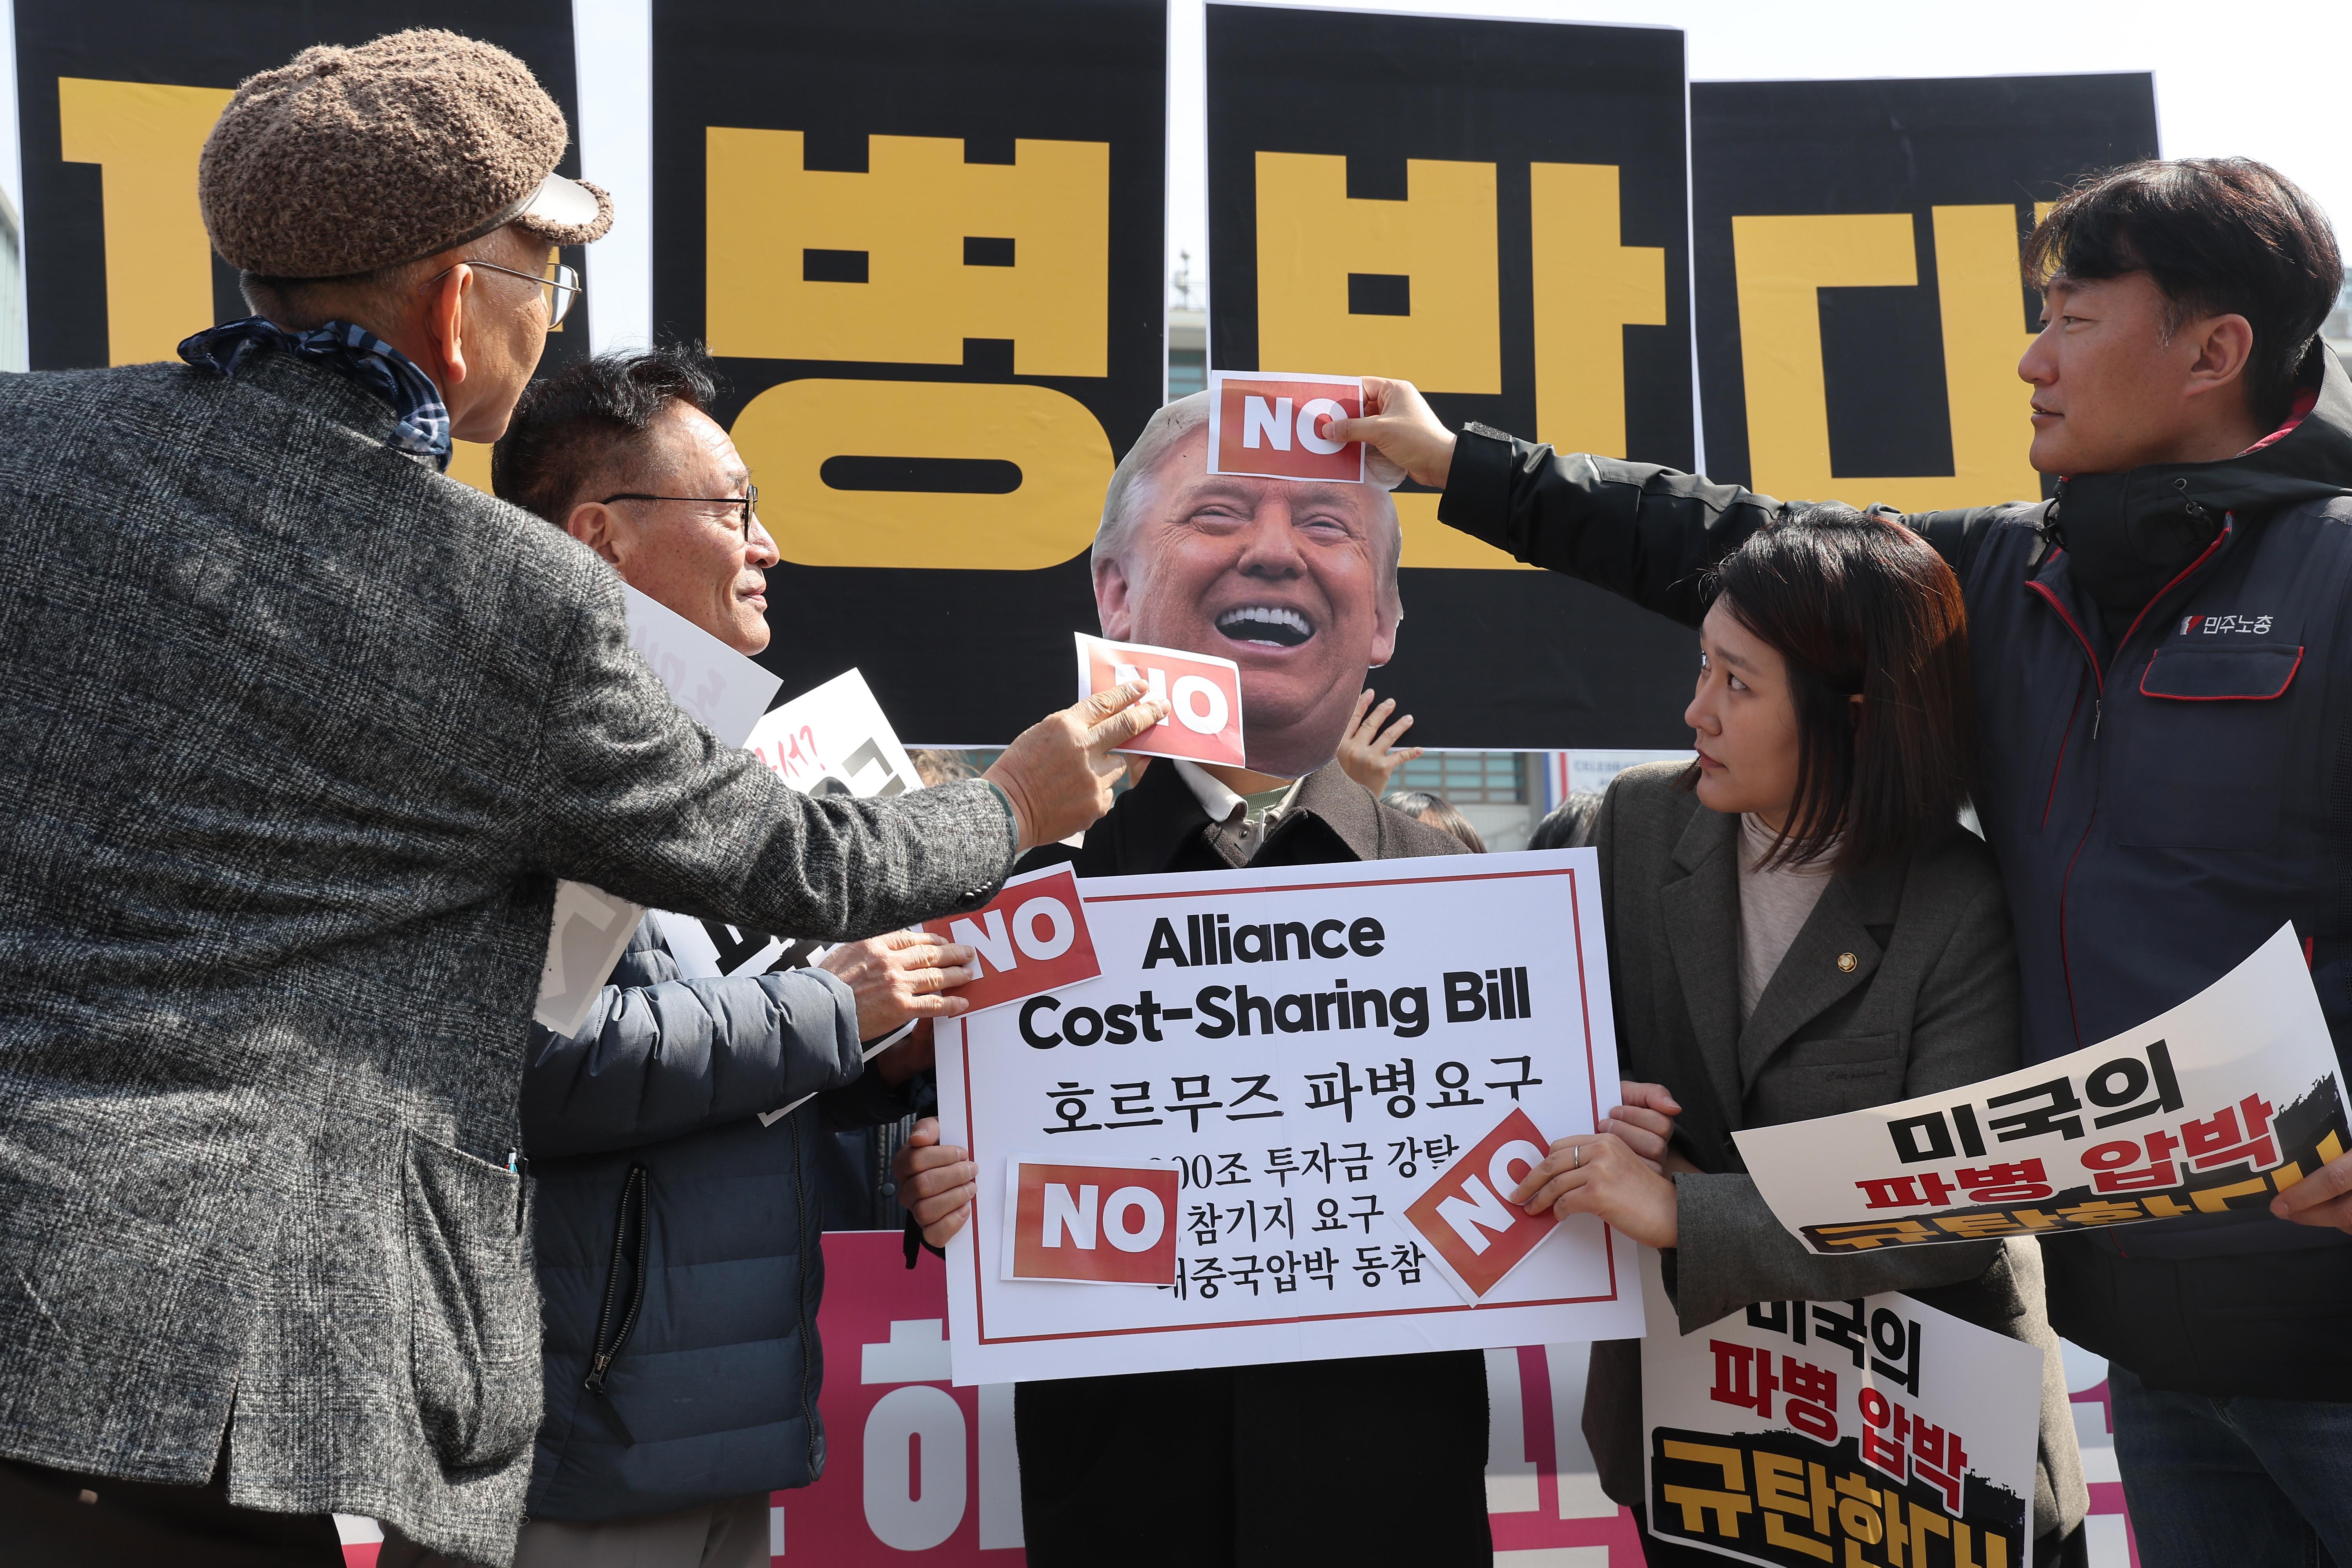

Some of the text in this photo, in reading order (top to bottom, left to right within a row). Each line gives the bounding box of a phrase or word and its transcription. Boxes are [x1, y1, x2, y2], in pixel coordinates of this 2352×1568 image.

[1243, 396, 1348, 454] NO
[2203, 615, 2273, 635] 민주노총
[1114, 664, 1229, 735] NO
[949, 896, 1075, 980] NO
[1142, 913, 1385, 969] Alliance
[1019, 966, 1531, 1049] Cost-Sharing Bill
[1043, 1055, 1543, 1134] 호르무즈 파병요구
[1887, 1038, 2185, 1164] 미국의
[1263, 1141, 1374, 1188] 투자금
[1855, 1092, 2278, 1209] 파병 압박
[1042, 1183, 1165, 1253] NO
[1311, 1194, 1384, 1234] 요구
[1435, 1140, 1546, 1256] NO
[1352, 1241, 1426, 1287] 동참
[1745, 1297, 1921, 1398] 미국의
[1709, 1339, 1838, 1442] 파병
[1857, 1387, 1968, 1513] 압박
